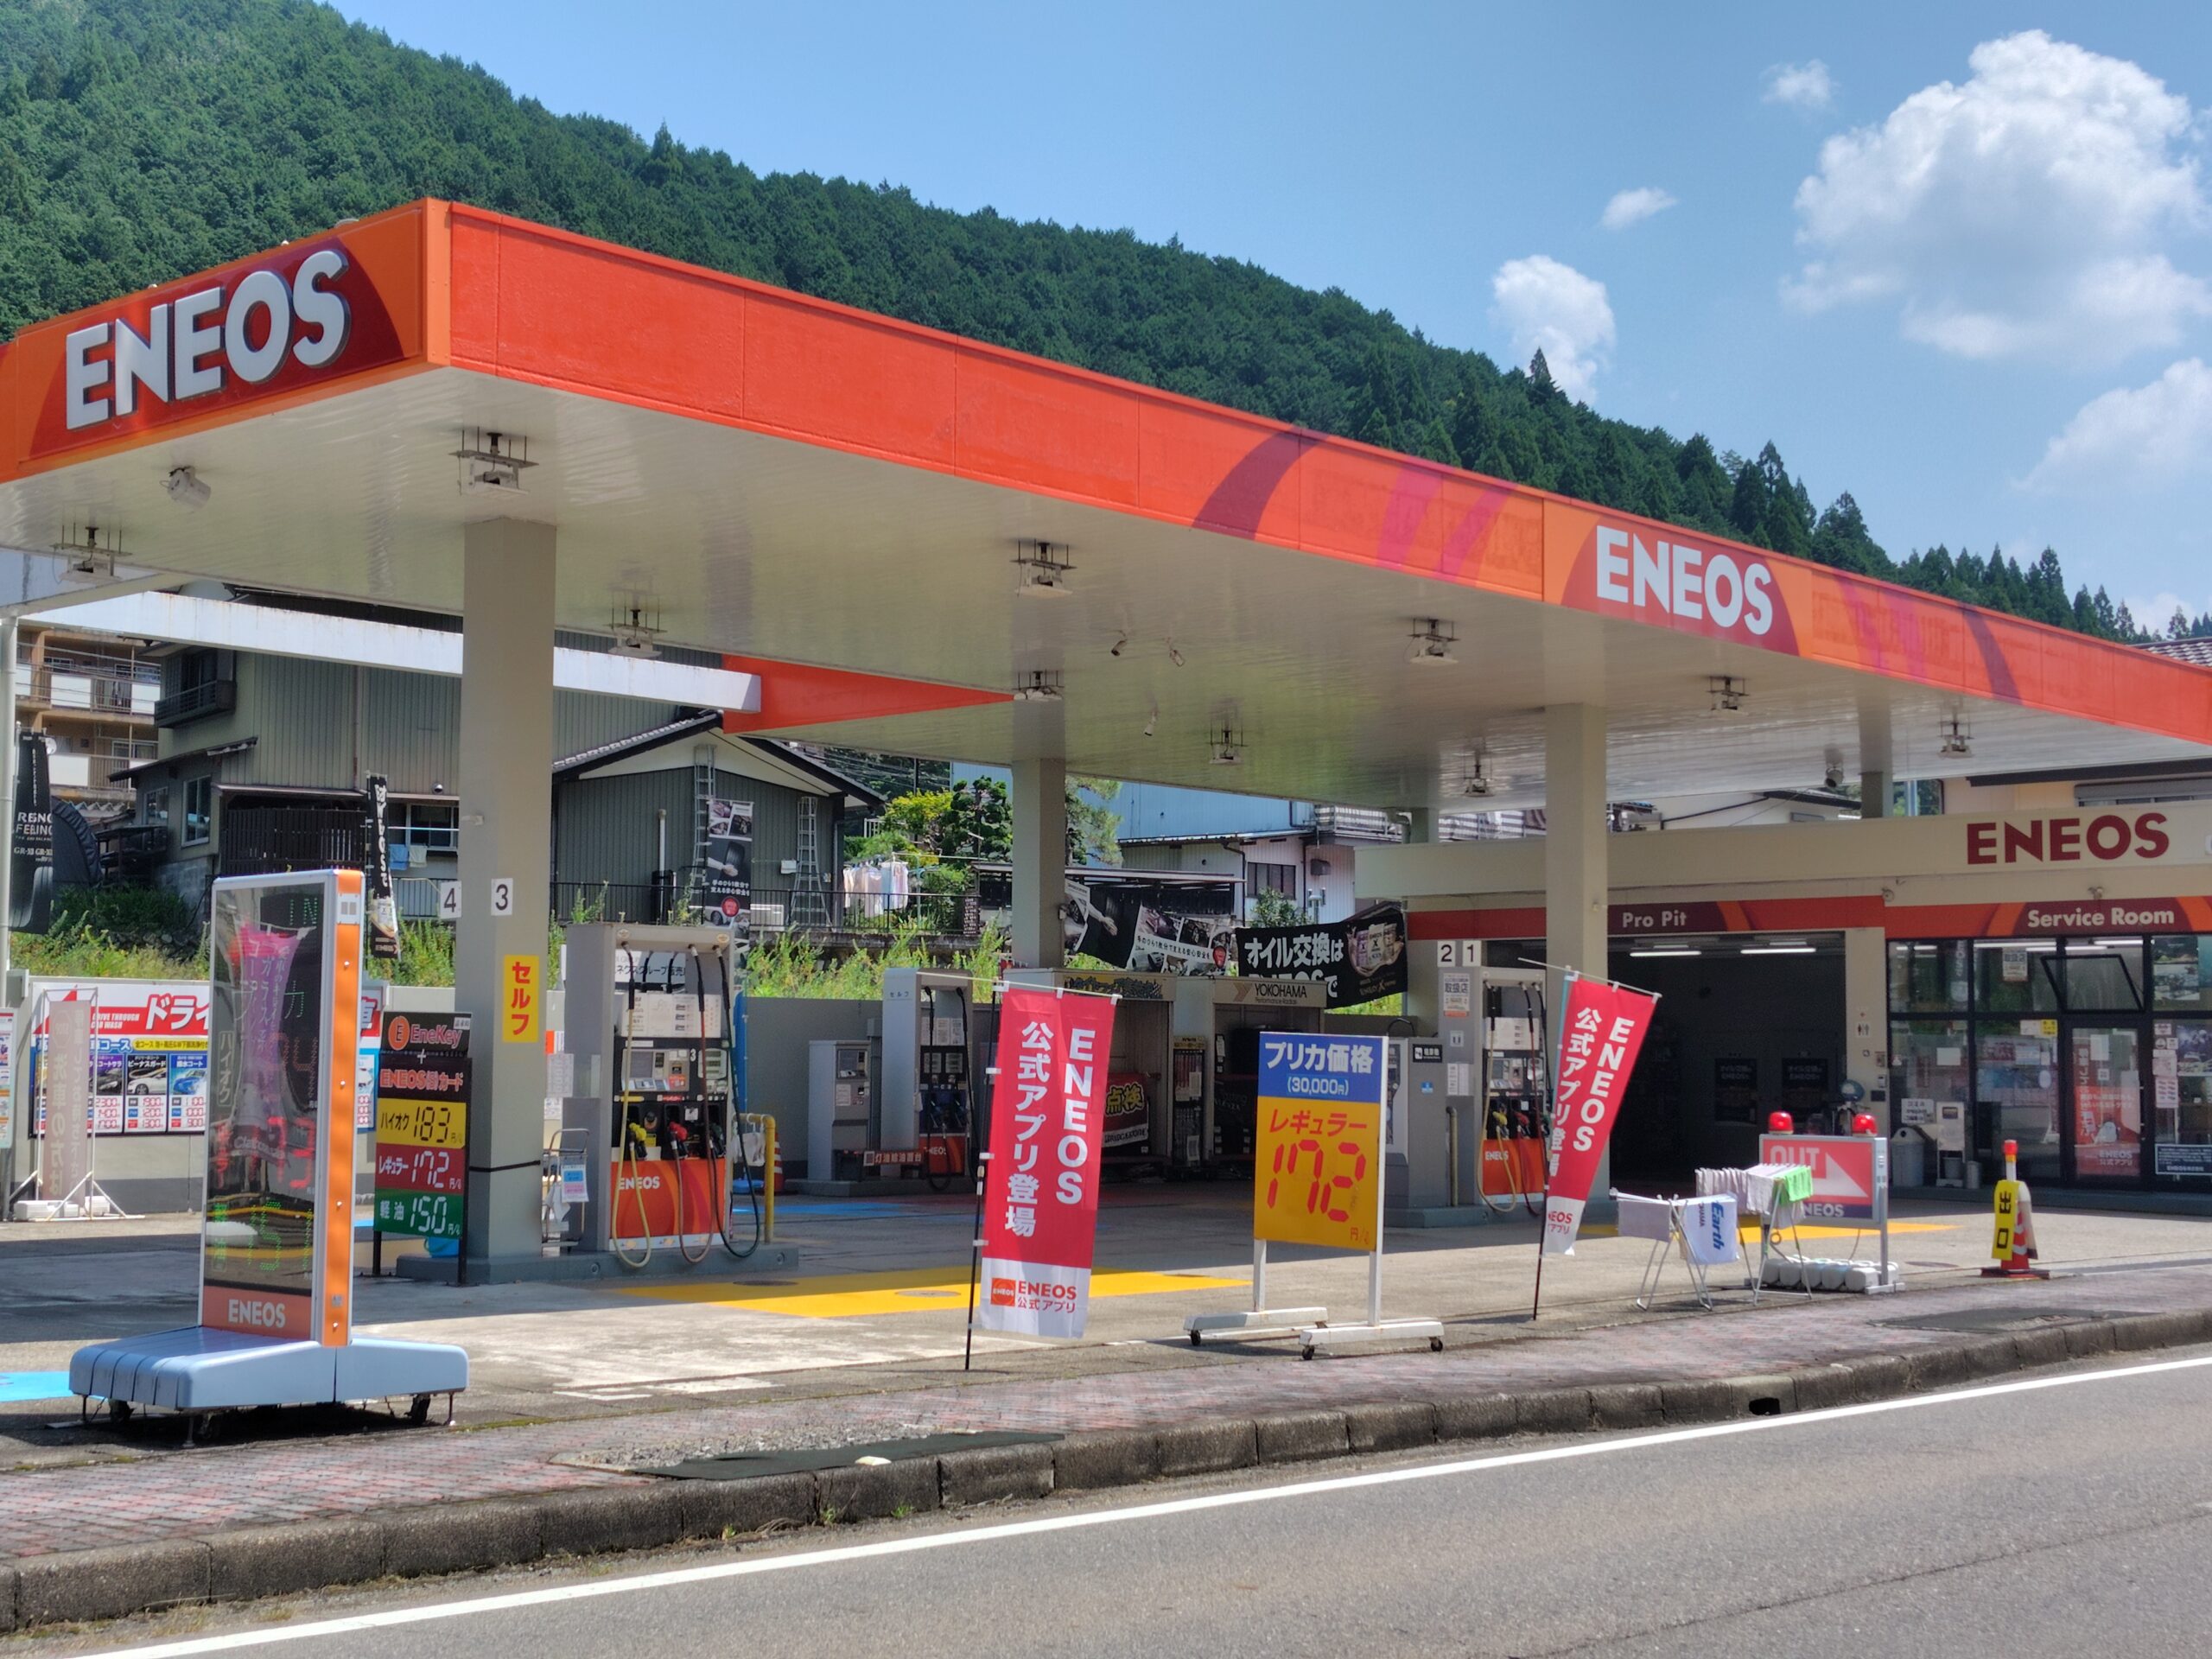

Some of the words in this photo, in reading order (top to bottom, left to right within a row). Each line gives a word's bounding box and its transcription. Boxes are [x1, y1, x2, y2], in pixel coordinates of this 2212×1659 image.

[66, 250, 350, 430] ENEOS
[1596, 524, 1773, 636] ENEOS
[1967, 811, 2170, 865] ENEOS
[289, 898, 317, 925] IN
[443, 887, 456, 912] 4
[495, 884, 508, 911] 3
[1622, 911, 1654, 928] Pro
[1660, 910, 1687, 927] Pit
[2026, 907, 2104, 928] Service
[2110, 906, 2175, 926] Room
[1244, 931, 1344, 969] オイル交換は
[1440, 944, 1452, 962] 2
[1466, 944, 1474, 962] 1
[512, 962, 531, 1035] セルフ
[1255, 983, 1307, 998] YOKOHAMA
[410, 1023, 462, 1050] EneKey
[219, 1033, 233, 1103] ハイオク
[690, 1049, 696, 1062] 3
[1264, 1041, 1374, 1074] プリカ価格
[1287, 1077, 1349, 1096] (30,000円)
[1573, 1016, 1635, 1152] ENEOS
[1106, 1083, 1143, 1115] 点検
[380, 1111, 410, 1132] ハイオク
[413, 1106, 450, 1144] 183
[1004, 1021, 1054, 1238] 公式アプリ登場
[1056, 1027, 1096, 1205] ENEOS
[1269, 1109, 1368, 1137] レギュラー
[378, 1154, 409, 1176] レギュラー
[411, 1150, 449, 1189] 172
[1770, 1145, 1820, 1170] OUT
[618, 1176, 660, 1190] ENEOS
[1267, 1139, 1367, 1223] 172
[410, 1196, 448, 1235] 150
[1802, 1203, 1845, 1217] NEOS
[1997, 1191, 2012, 1249] 出口
[1711, 1202, 1726, 1251] Earth
[1018, 1280, 1077, 1300] ENEOS
[228, 1299, 286, 1328] ENEOS
[1018, 1296, 1076, 1314] 公式アプリ
